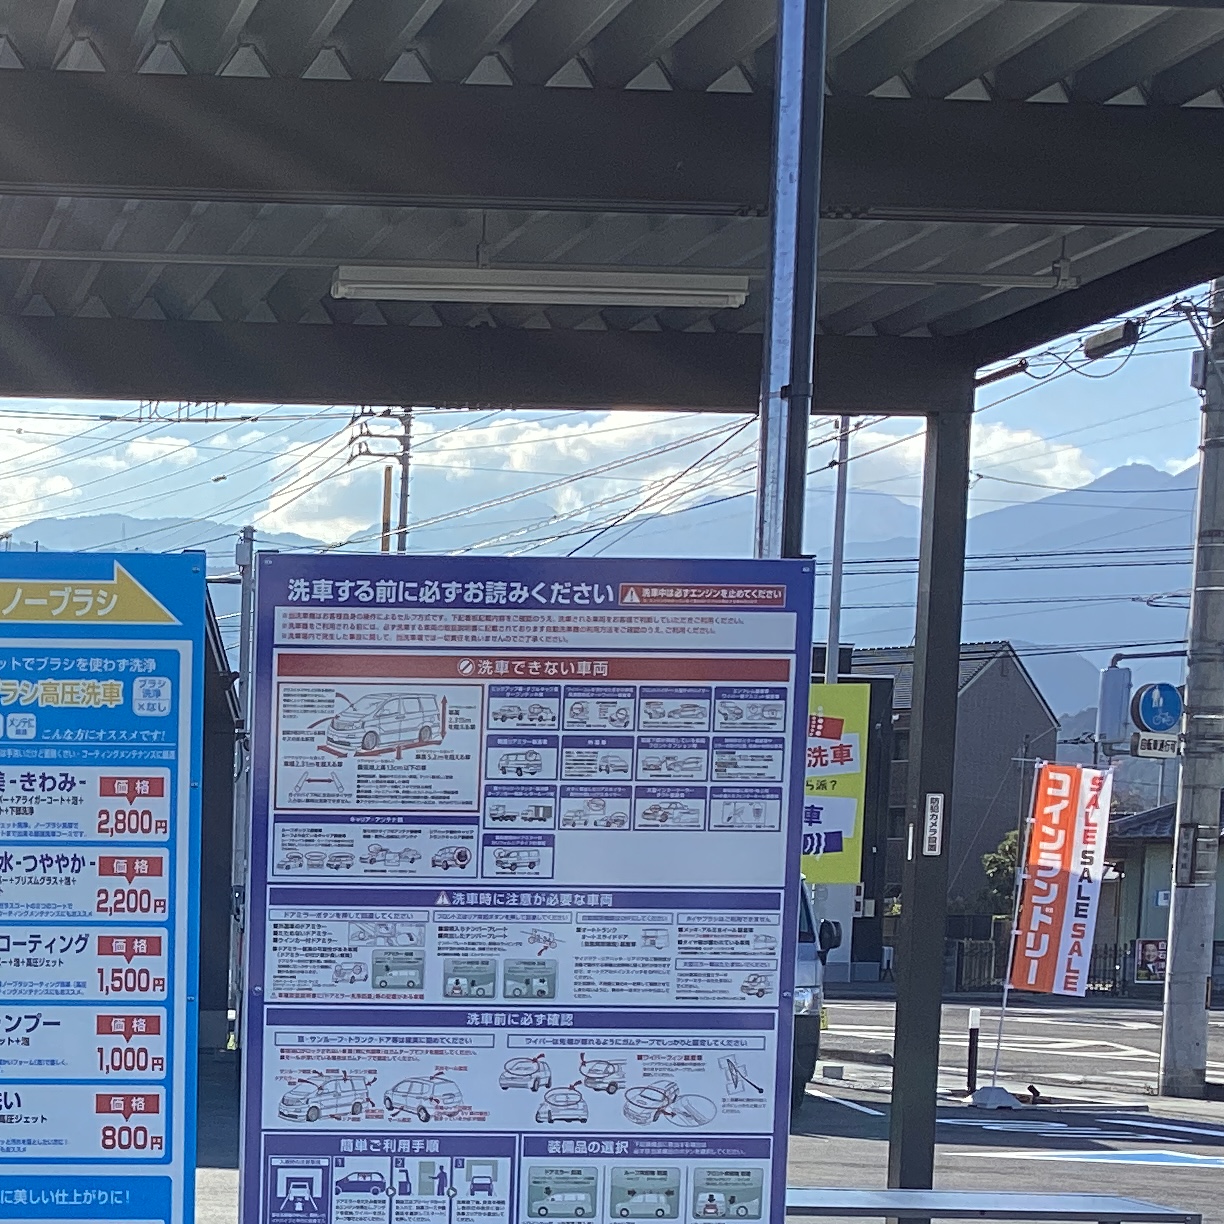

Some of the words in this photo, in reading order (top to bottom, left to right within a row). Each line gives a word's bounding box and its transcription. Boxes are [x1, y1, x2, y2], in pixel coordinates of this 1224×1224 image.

[1, 586, 118, 617] ノーブラシ
[287, 577, 614, 605] 洗車する前に必ずお読みください
[477, 659, 609, 677] 洗車できない車両
[138, 679, 166, 689] ブラシ
[41, 728, 166, 742] こんな方にオススメです!
[807, 743, 853, 767] 洗車
[113, 779, 150, 795] 価格
[1082, 775, 1105, 846] SALE
[97, 809, 168, 838] 2,800円
[113, 859, 150, 875] 価格
[1024, 770, 1072, 986] コインランドリー
[1075, 849, 1096, 919] SALE
[96, 888, 167, 917] 2,200円
[452, 891, 613, 907] 洗車時に注意が必要な車両
[112, 938, 148, 954] 価格
[1063, 922, 1086, 993] SALE
[97, 967, 165, 996] 1,500円
[111, 1017, 147, 1032] 価格
[467, 1013, 574, 1027] 洗車前に必ず確認
[96, 1047, 164, 1075] 1,000円
[110, 1096, 146, 1111] 価格
[101, 1125, 163, 1150] 800円
[340, 1138, 440, 1153] 簡単ご利用手順
[548, 1140, 629, 1155] 装備品の選択
